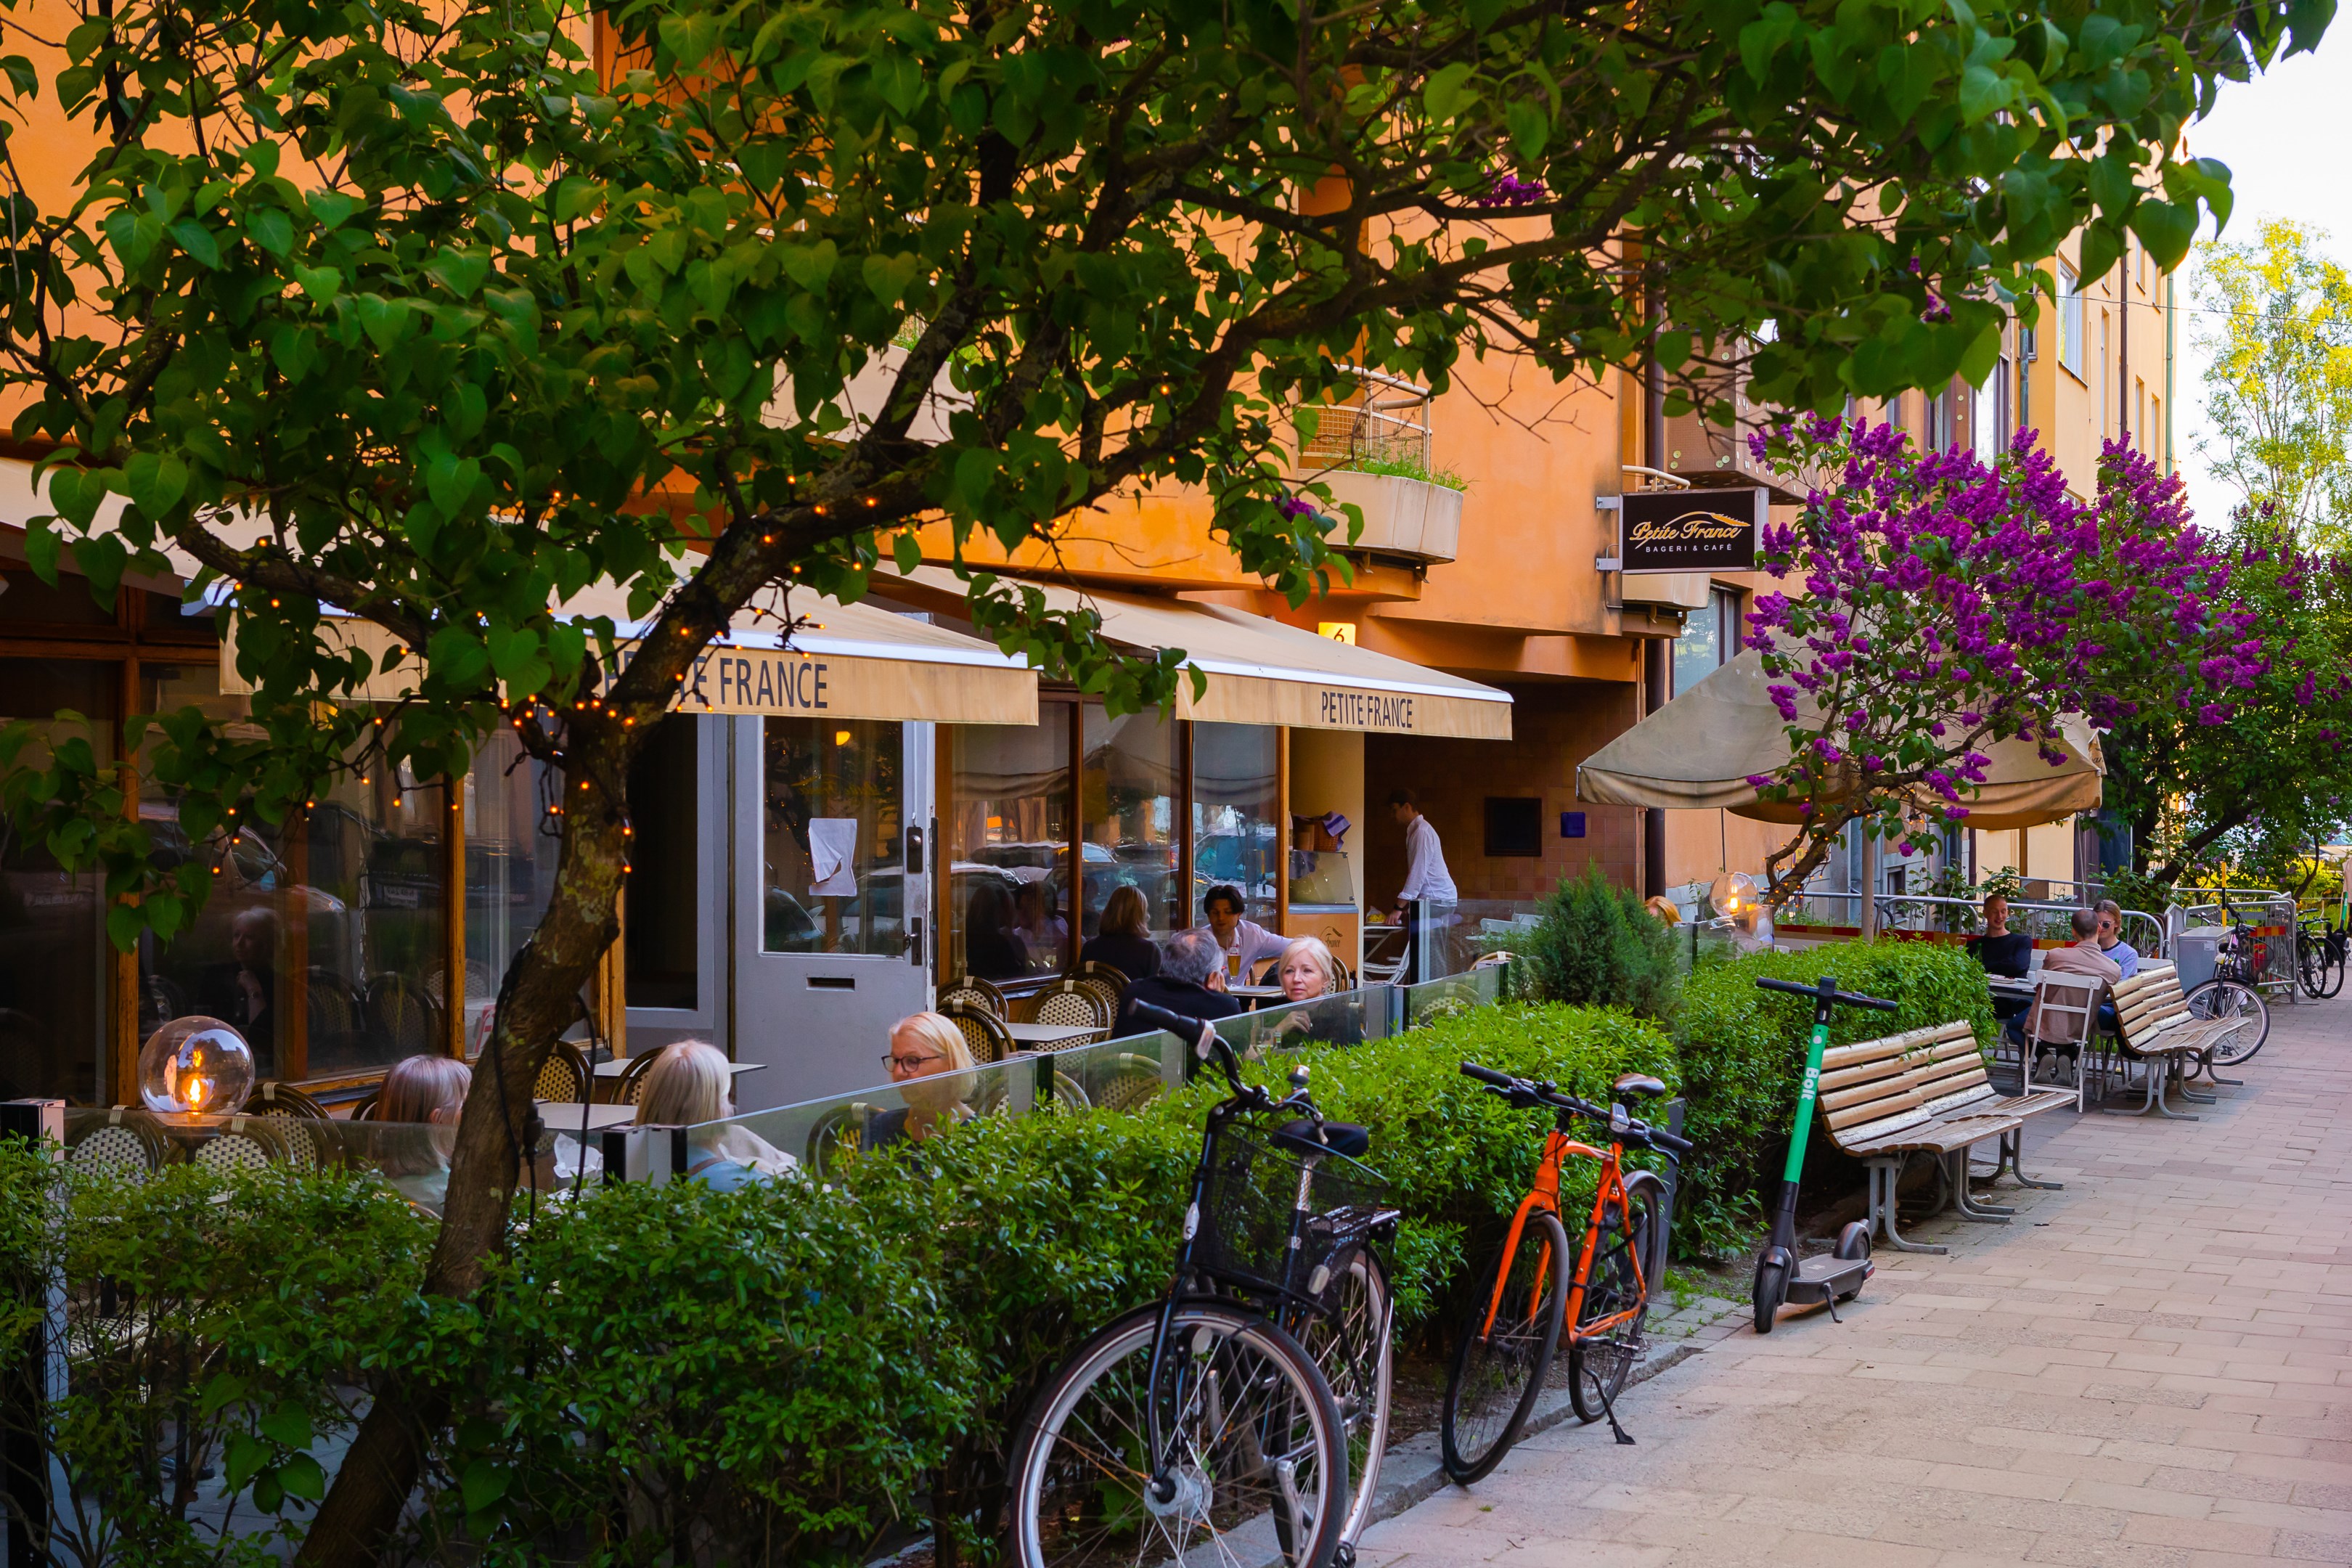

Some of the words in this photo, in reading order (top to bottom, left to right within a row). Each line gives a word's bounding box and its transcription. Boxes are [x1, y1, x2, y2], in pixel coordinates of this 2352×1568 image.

[1629, 521, 1679, 550] Petite
[1681, 520, 1741, 539] France
[1334, 628, 1344, 642] 6
[720, 657, 828, 709] FRANCE
[1322, 691, 1363, 725] PETITE
[1367, 695, 1413, 728] FRANCE
[1801, 1067, 1819, 1100] Bolt
